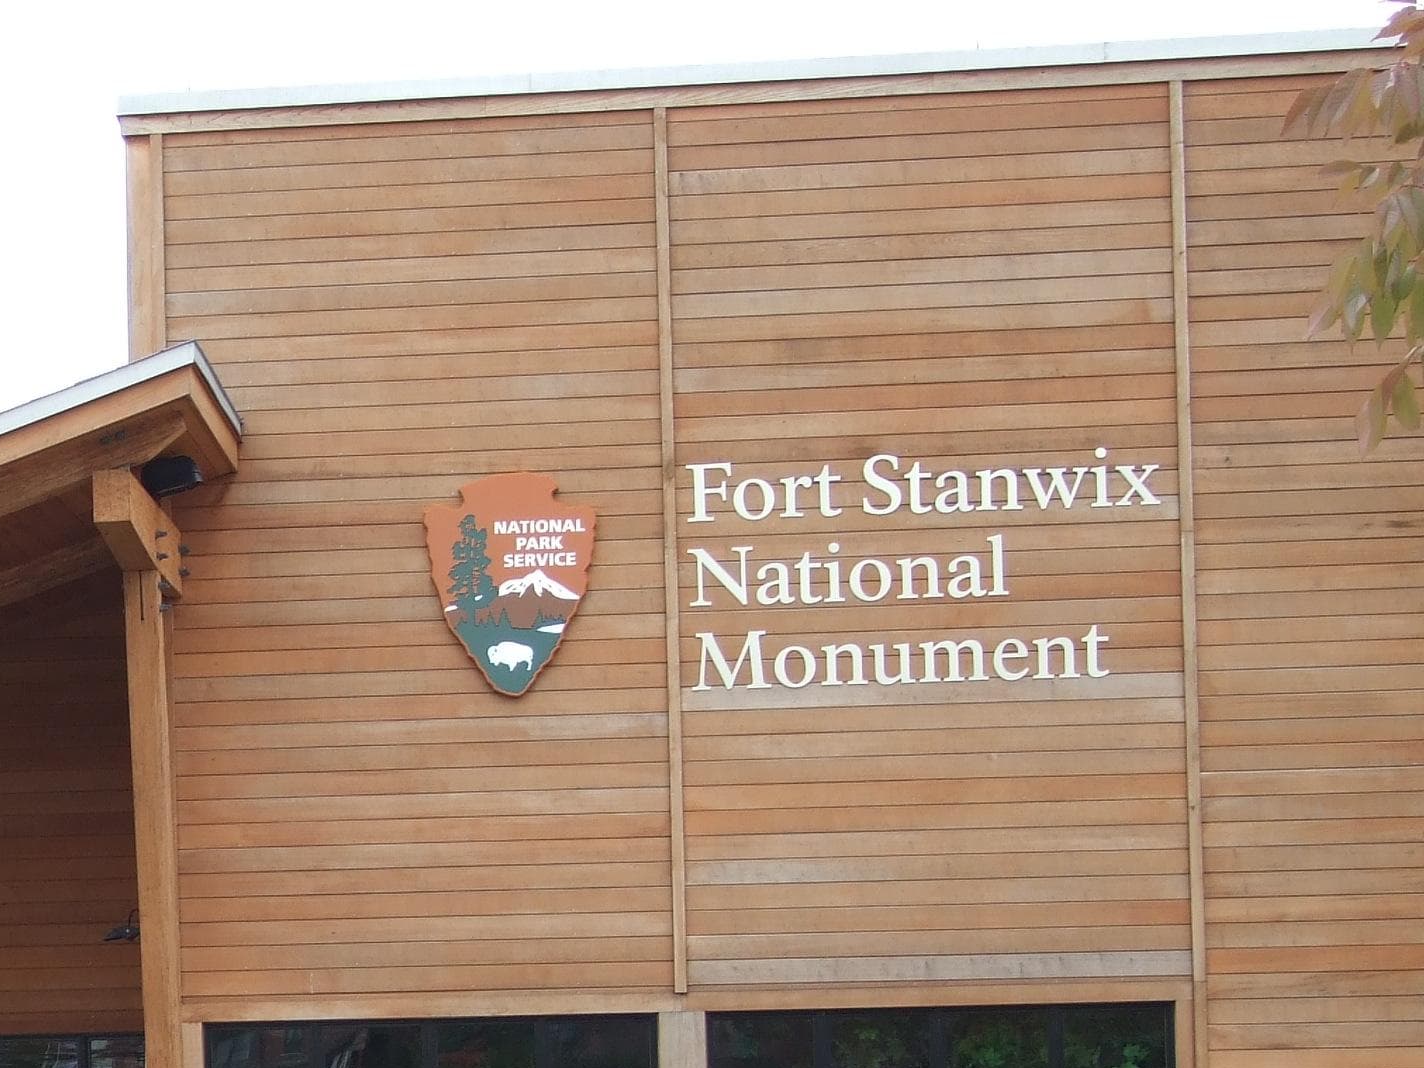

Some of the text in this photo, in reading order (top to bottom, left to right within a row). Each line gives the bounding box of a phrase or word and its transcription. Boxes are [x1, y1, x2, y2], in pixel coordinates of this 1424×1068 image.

[686, 448, 1160, 522] Fort Stanwix
[495, 519, 585, 533] NATIONAL
[517, 536, 563, 550] PARK
[504, 553, 576, 567] SERVICE
[688, 535, 1008, 605] National
[693, 625, 1109, 690] Monument
